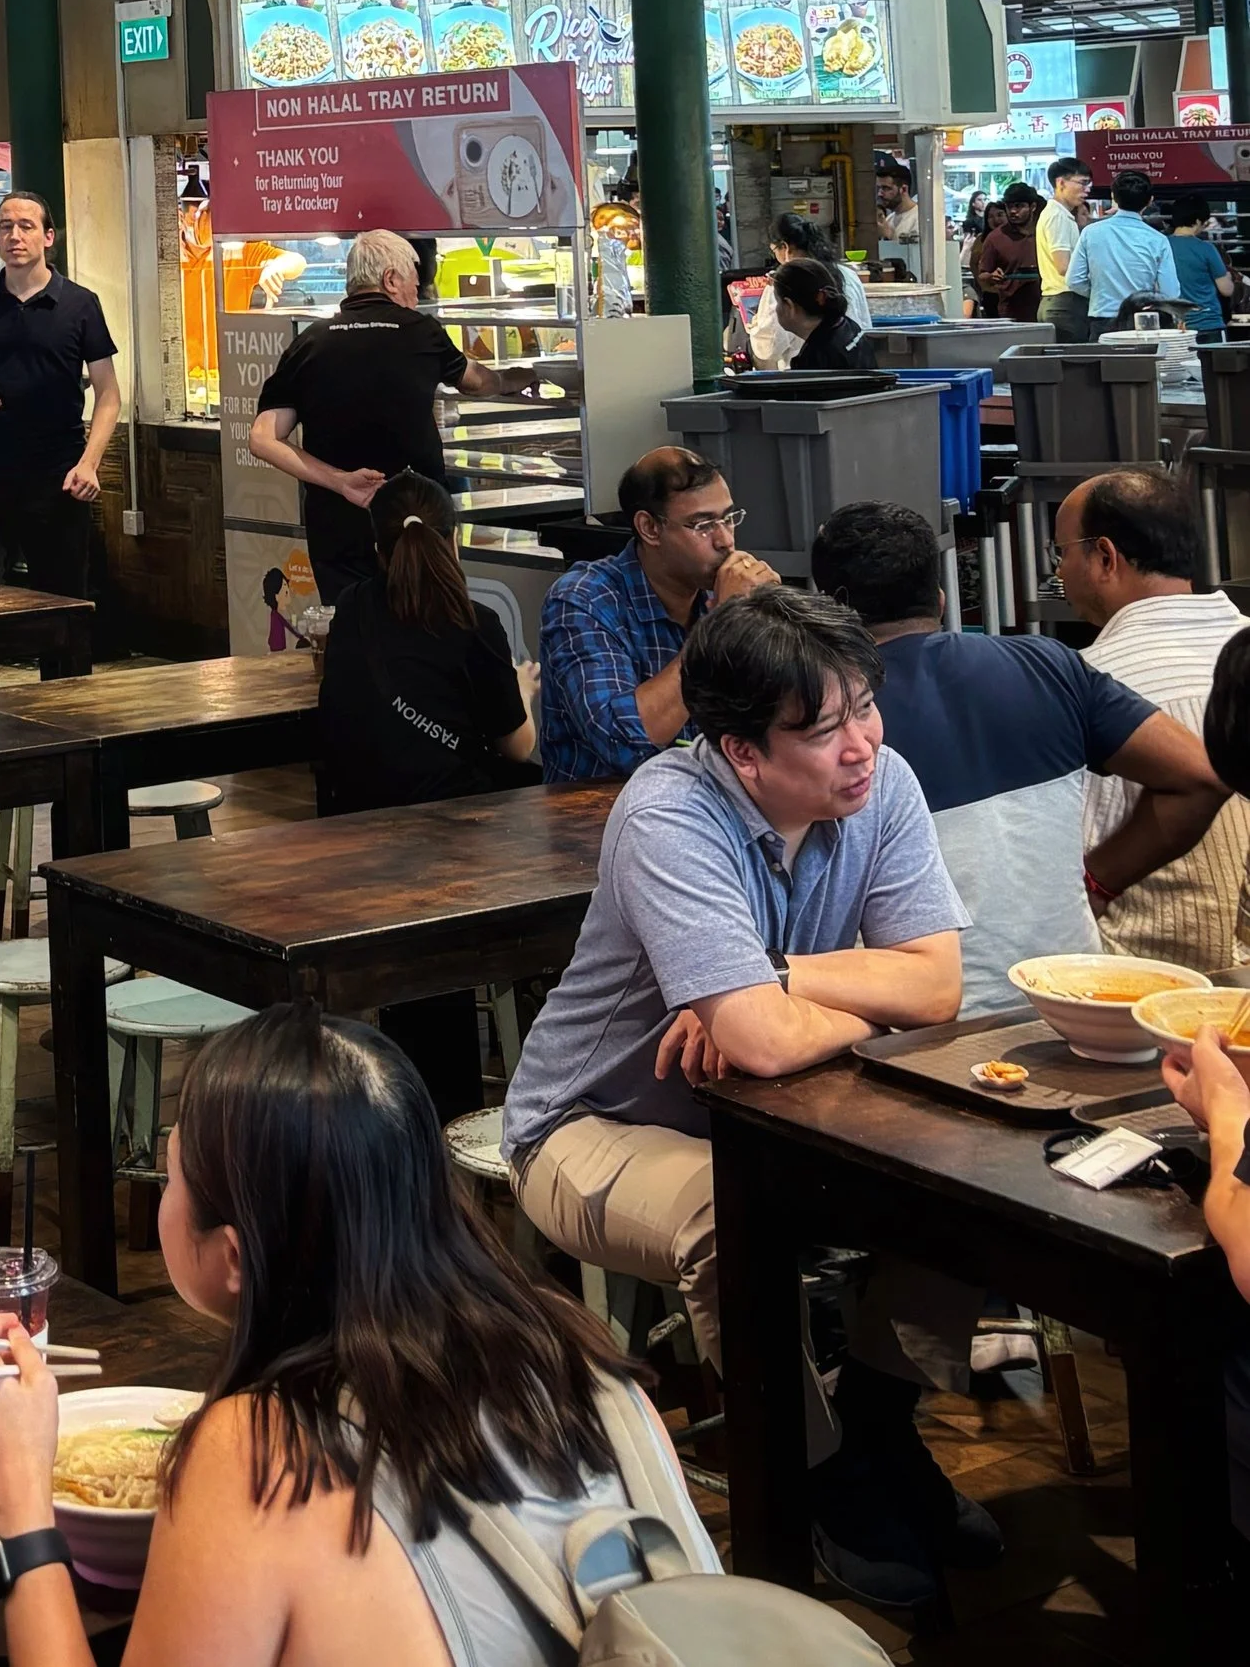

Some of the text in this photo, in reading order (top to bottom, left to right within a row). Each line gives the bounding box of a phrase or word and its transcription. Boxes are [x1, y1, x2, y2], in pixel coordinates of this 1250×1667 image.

[124, 25, 155, 55] EXIT
[524, 4, 594, 62] Rice
[583, 40, 634, 68] Noodl
[266, 81, 499, 119] NON HALAL TRAY RETURN
[1115, 133, 1139, 142] NON
[1142, 131, 1179, 141] HALAL
[1182, 129, 1211, 139] TRAY
[256, 146, 340, 169] THANK YOU
[1109, 151, 1163, 161] THANK YOU
[255, 173, 344, 193] for Returning Your
[261, 194, 339, 215] Tray & Crockery
[224, 330, 285, 357] THANK
[223, 396, 240, 415] FOR
[391, 694, 461, 751] FASHION
